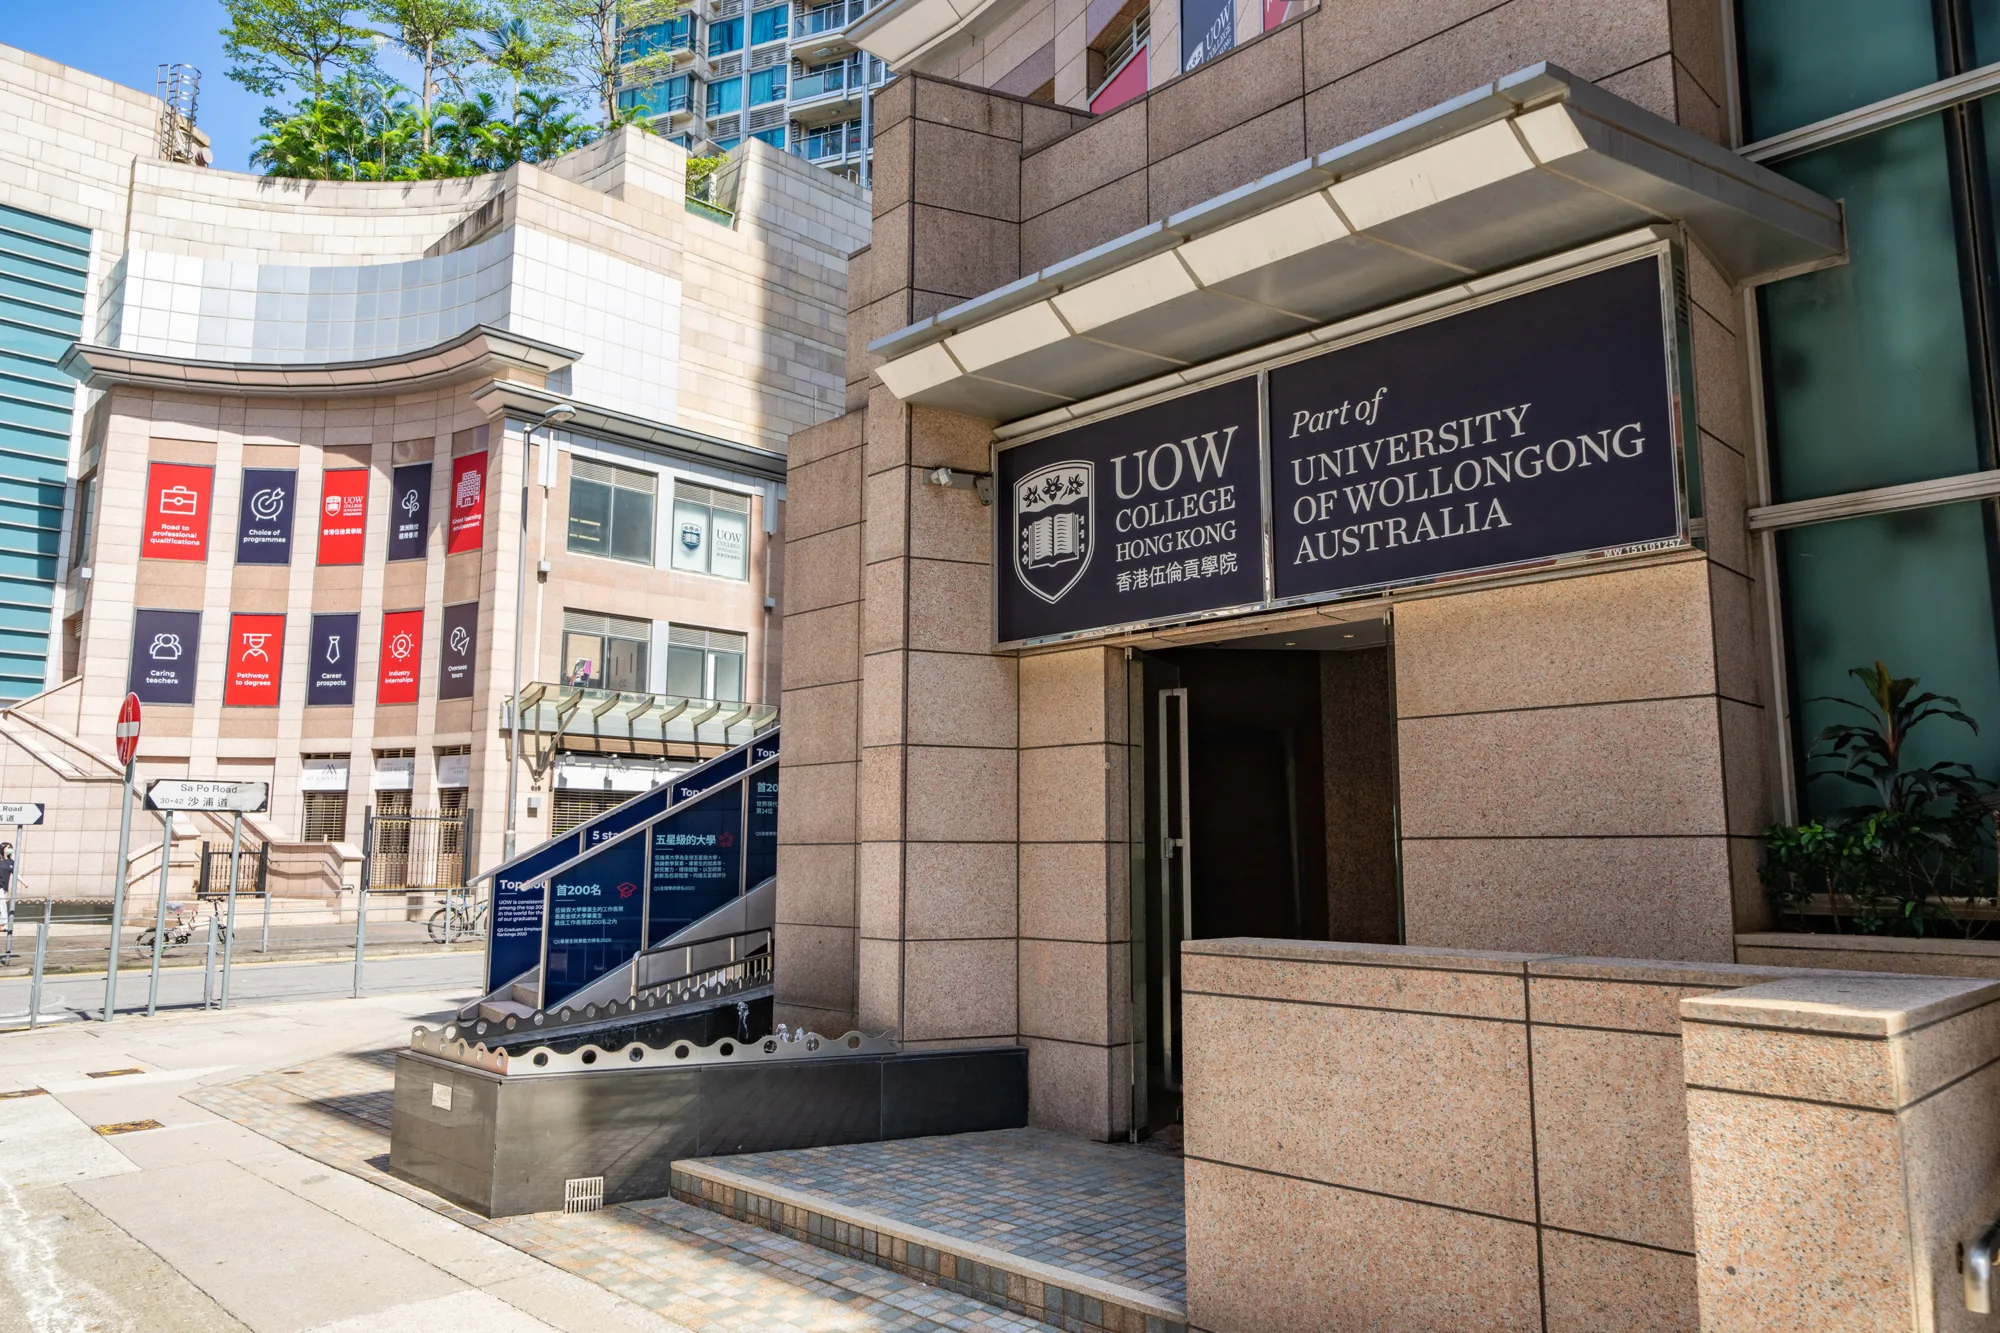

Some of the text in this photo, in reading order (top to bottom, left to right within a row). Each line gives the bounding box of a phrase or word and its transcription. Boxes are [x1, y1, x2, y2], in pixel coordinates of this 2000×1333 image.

[1206, 0, 1232, 50] UOW
[1289, 387, 1387, 438] Part of
[1291, 403, 1531, 486] UNIVERSITY
[1110, 425, 1239, 500] UOW
[1294, 422, 1646, 525] OF WOLLONGONG
[343, 496, 363, 504] UOW
[1116, 485, 1236, 532] COLLEGE
[452, 517, 464, 525] Great
[453, 521, 480, 531] environment
[152, 531, 197, 539] professional
[716, 529, 742, 542] UOW
[1294, 497, 1512, 565] AUSTRALIA
[150, 537, 200, 546] qualifications
[1116, 520, 1237, 562] HONG KONG
[1604, 549, 1622, 557] MW
[1116, 552, 1238, 592] 香港伍倫貢學院
[150, 670, 175, 678] Caring
[388, 670, 410, 678] Industry
[756, 748, 775, 757] Top
[180, 784, 193, 792] Sa
[212, 785, 238, 794] Road
[681, 788, 700, 797] Top
[187, 796, 228, 808] 沙浦道
[592, 831, 600, 840] 5
[656, 834, 716, 846] 五星級的大學
[499, 880, 522, 892] Top
[556, 884, 602, 896] 首200名
